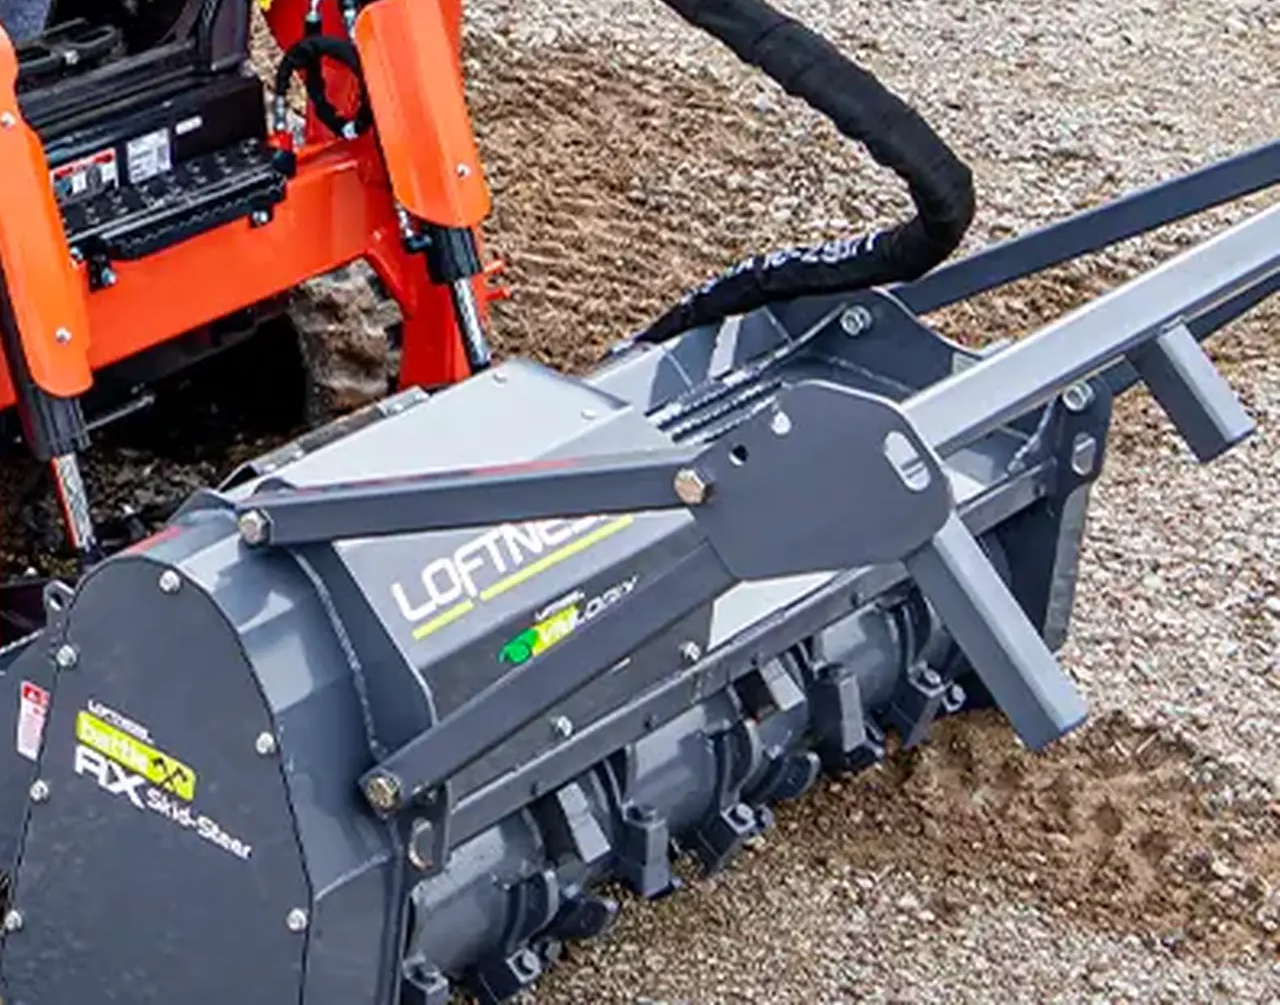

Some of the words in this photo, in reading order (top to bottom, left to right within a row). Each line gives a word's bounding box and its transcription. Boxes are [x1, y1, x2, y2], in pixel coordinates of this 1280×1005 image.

[391, 515, 610, 622] LOFTNE
[75, 744, 147, 809] AX
[146, 787, 252, 860] Skid-Steer
